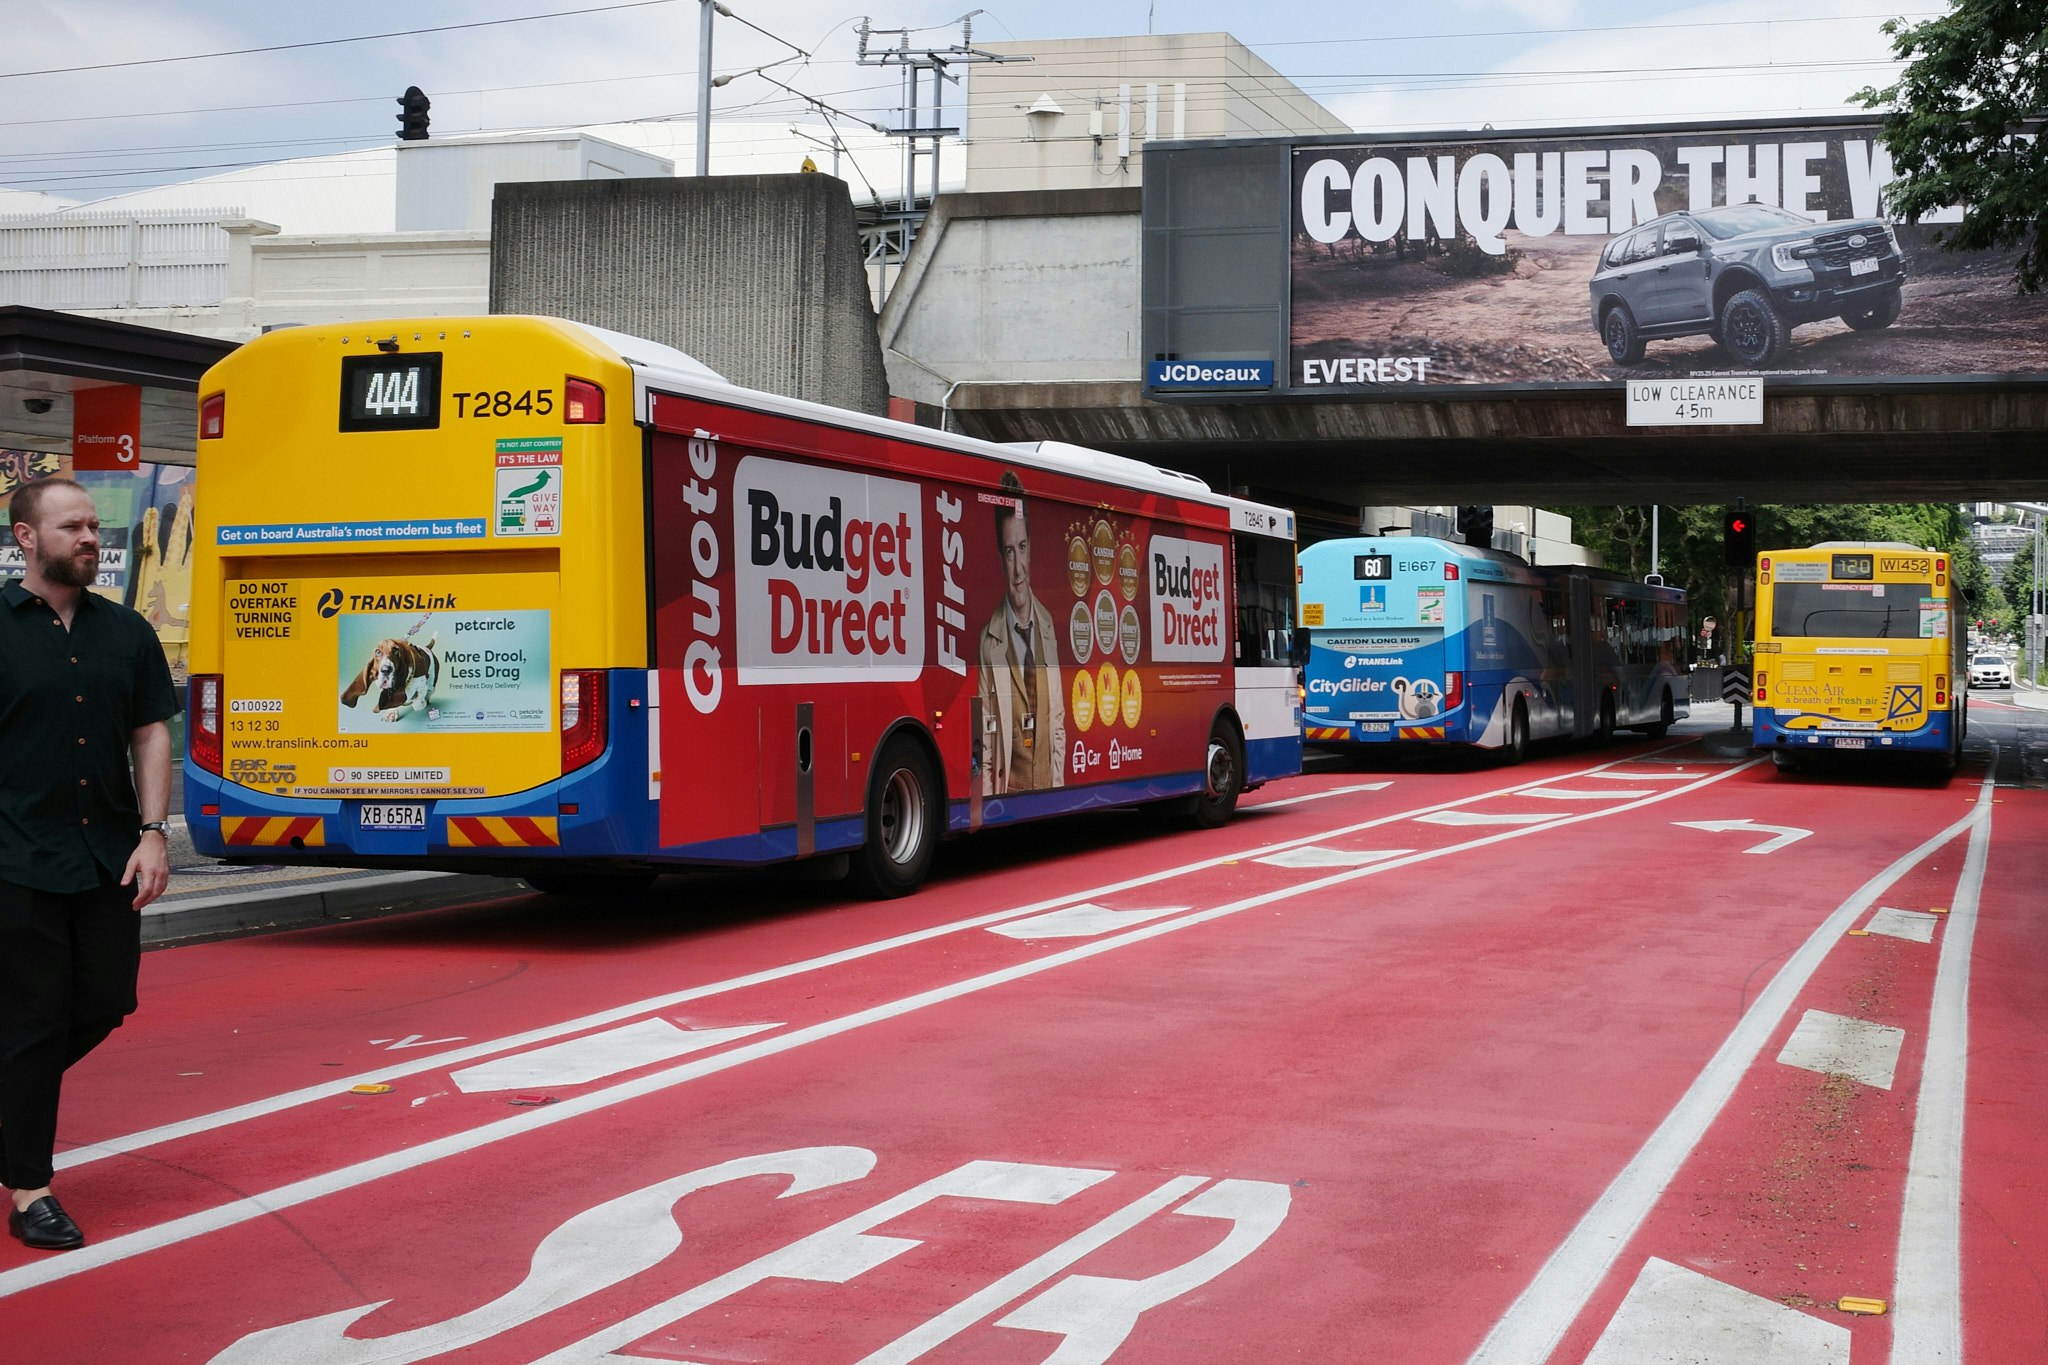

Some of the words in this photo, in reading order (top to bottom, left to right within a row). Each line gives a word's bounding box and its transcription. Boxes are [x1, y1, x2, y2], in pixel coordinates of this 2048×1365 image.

[1301, 148, 1663, 256] CONQUER
[1677, 141, 1828, 222] THE
[1160, 364, 1261, 382] JCDecaux
[1303, 357, 1431, 385] EVEREST
[365, 370, 420, 415] 444
[1633, 386, 1662, 402] LOW
[1670, 384, 1757, 401] CLEARANCE
[453, 389, 554, 419] T2845
[78, 434, 116, 444] Platform
[116, 434, 135, 463] 3
[498, 455, 515, 464] IT'S
[517, 454, 536, 463] THE
[538, 453, 560, 463] LAW
[532, 493, 559, 502] GIVE
[533, 503, 557, 513] WAY
[1244, 511, 1264, 529] T2845
[221, 529, 242, 541] Get
[244, 530, 259, 540] on
[261, 527, 294, 539] board
[296, 525, 353, 539] Australia's
[355, 526, 384, 537] most
[386, 524, 430, 536] modern
[432, 523, 454, 535] bus
[456, 522, 483, 534] fleet
[747, 488, 912, 595] Budget
[682, 427, 723, 715] Quote
[1364, 558, 1381, 577] 60
[240, 583, 258, 595] DO
[262, 582, 289, 595] NOT
[935, 489, 967, 678] First
[1154, 552, 1220, 611] Budget
[230, 597, 298, 610] OVERTAKE
[350, 593, 457, 611] TRANSLink
[235, 611, 293, 624] TURNING
[768, 578, 907, 656] Direct
[1162, 602, 1219, 647] Direct
[236, 626, 291, 638] VEHICLE
[455, 618, 516, 634] petcircle
[444, 651, 481, 663] More
[484, 649, 527, 664] Drool,
[1357, 657, 1404, 666] TRANSLink
[451, 667, 481, 679] Less
[485, 666, 520, 679] Drag
[480, 682, 493, 690] Day
[1309, 677, 1388, 697] CityGlider
[231, 700, 282, 711] Q100922
[1793, 696, 1822, 704] breath
[1824, 696, 1834, 704] of
[1837, 696, 1862, 705] fresh
[1866, 697, 1878, 705] air
[230, 720, 244, 731] 13
[248, 720, 262, 731] 12
[265, 720, 280, 731] 30
[231, 737, 369, 748] www.translink.com.au
[1087, 749, 1101, 766] Car
[1121, 745, 1143, 762] Home
[230, 771, 297, 783] VOLVO
[350, 771, 362, 780] 90
[367, 771, 400, 780] SPEED
[404, 771, 443, 780] LIMITED
